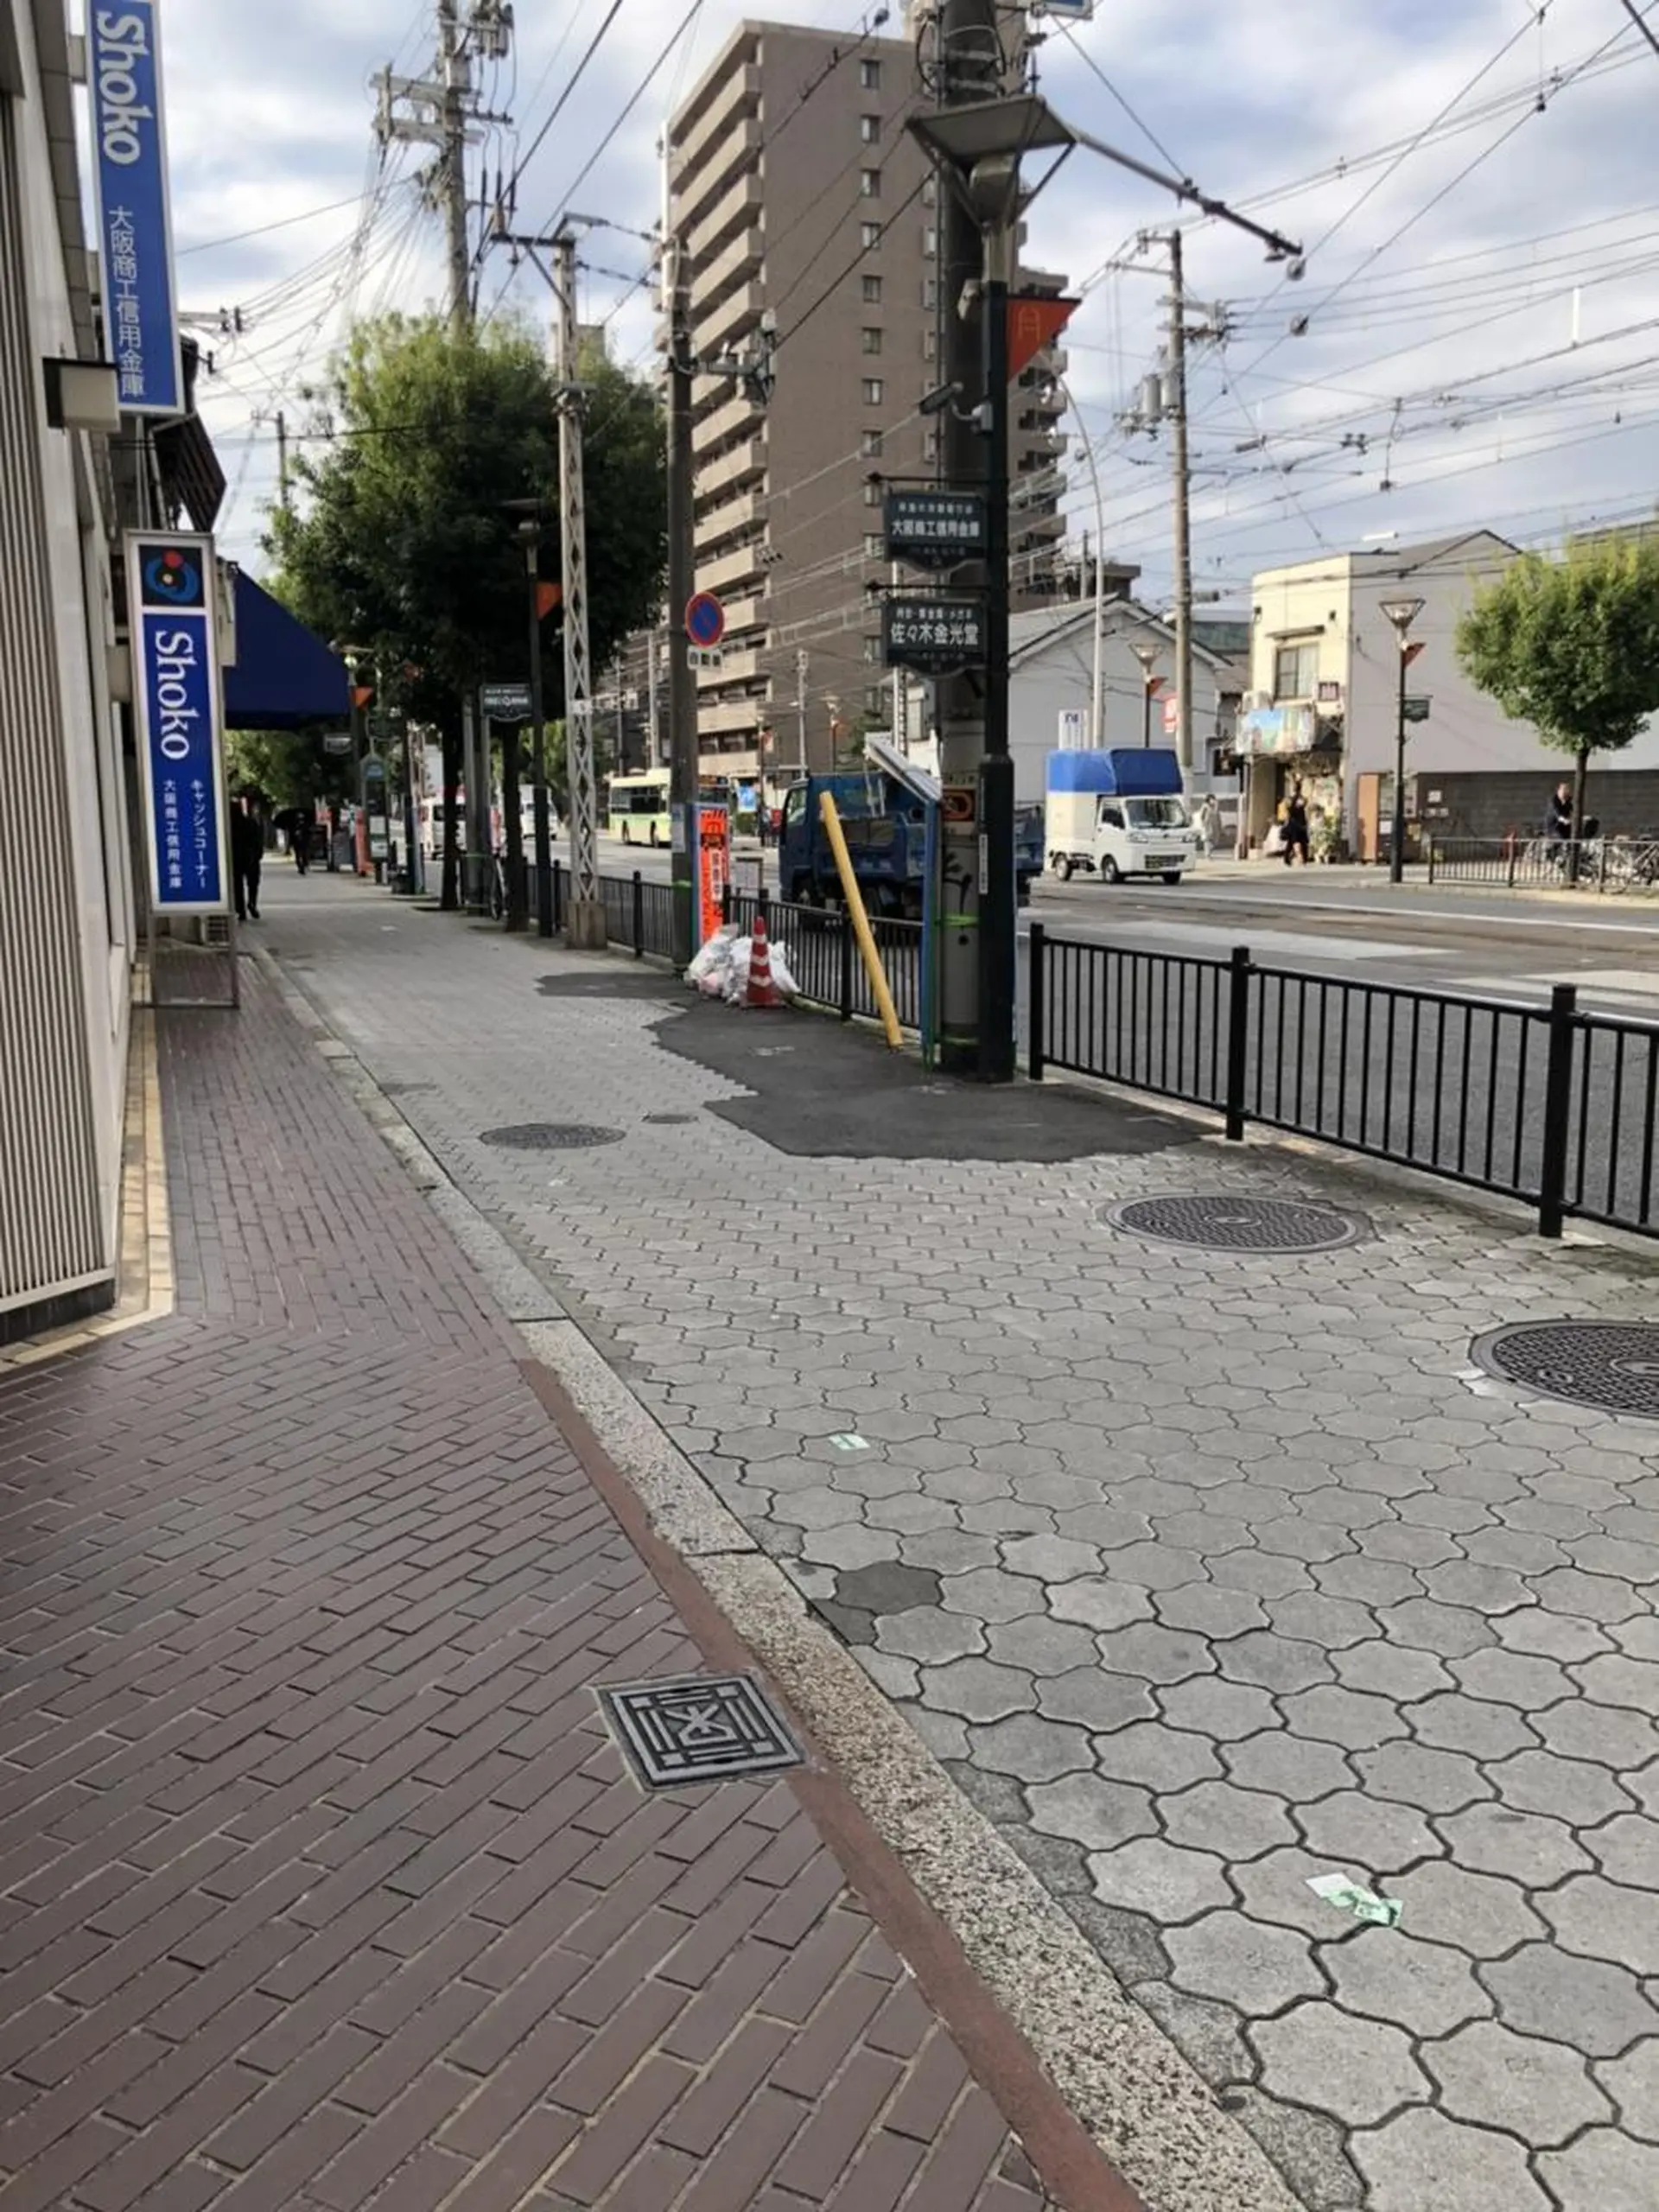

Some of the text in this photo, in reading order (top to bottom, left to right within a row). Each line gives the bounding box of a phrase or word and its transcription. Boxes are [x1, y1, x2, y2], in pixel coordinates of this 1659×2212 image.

[96, 11, 153, 166] Shoko
[109, 206, 145, 397] 大阪商工信用金庫
[155, 629, 200, 760] Shoko
